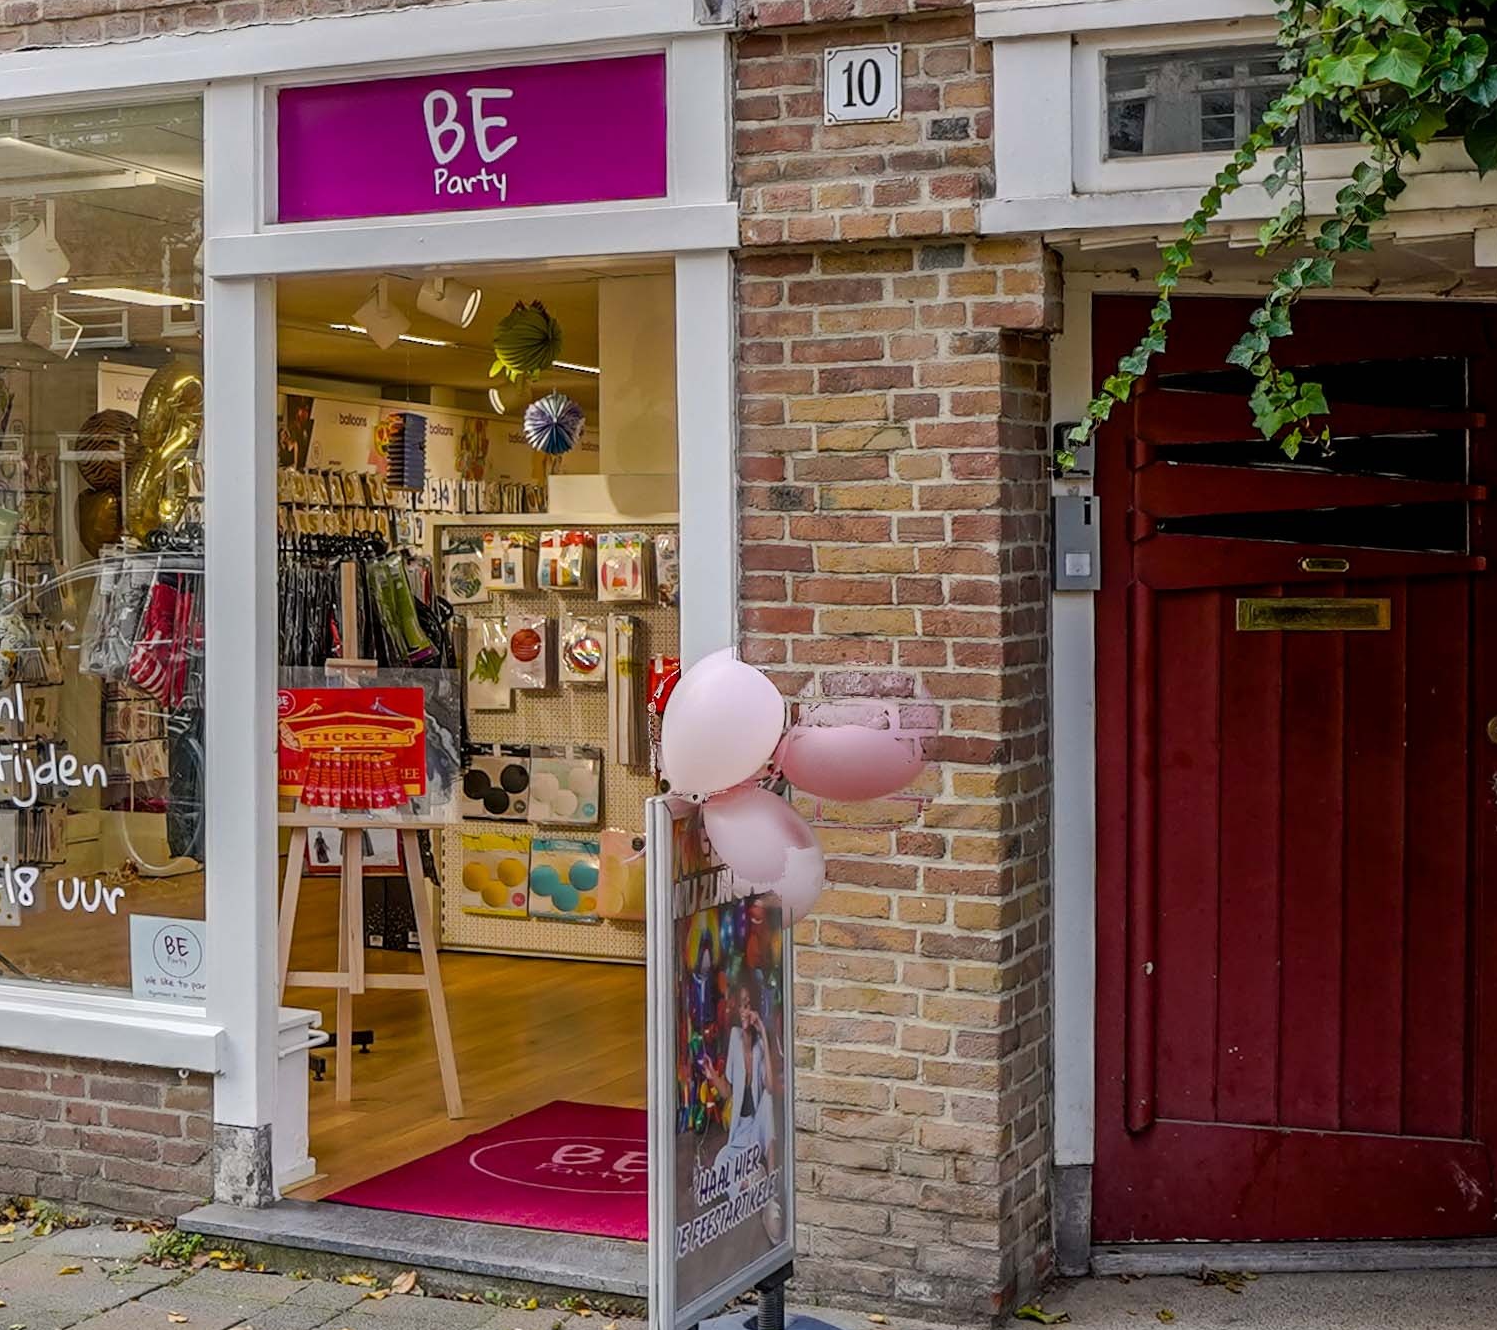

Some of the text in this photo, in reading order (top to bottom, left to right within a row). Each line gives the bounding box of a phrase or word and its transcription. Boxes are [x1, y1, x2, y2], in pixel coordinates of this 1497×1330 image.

[842, 59, 881, 107] 10
[422, 87, 518, 166] BE
[433, 167, 508, 201] Party
[304, 732, 392, 742] TICKET
[57, 877, 126, 917] uur
[164, 935, 189, 957] BE
[535, 1162, 635, 1183] Party
[552, 1144, 647, 1172] BE
[697, 1142, 762, 1203] HAAL HIER
